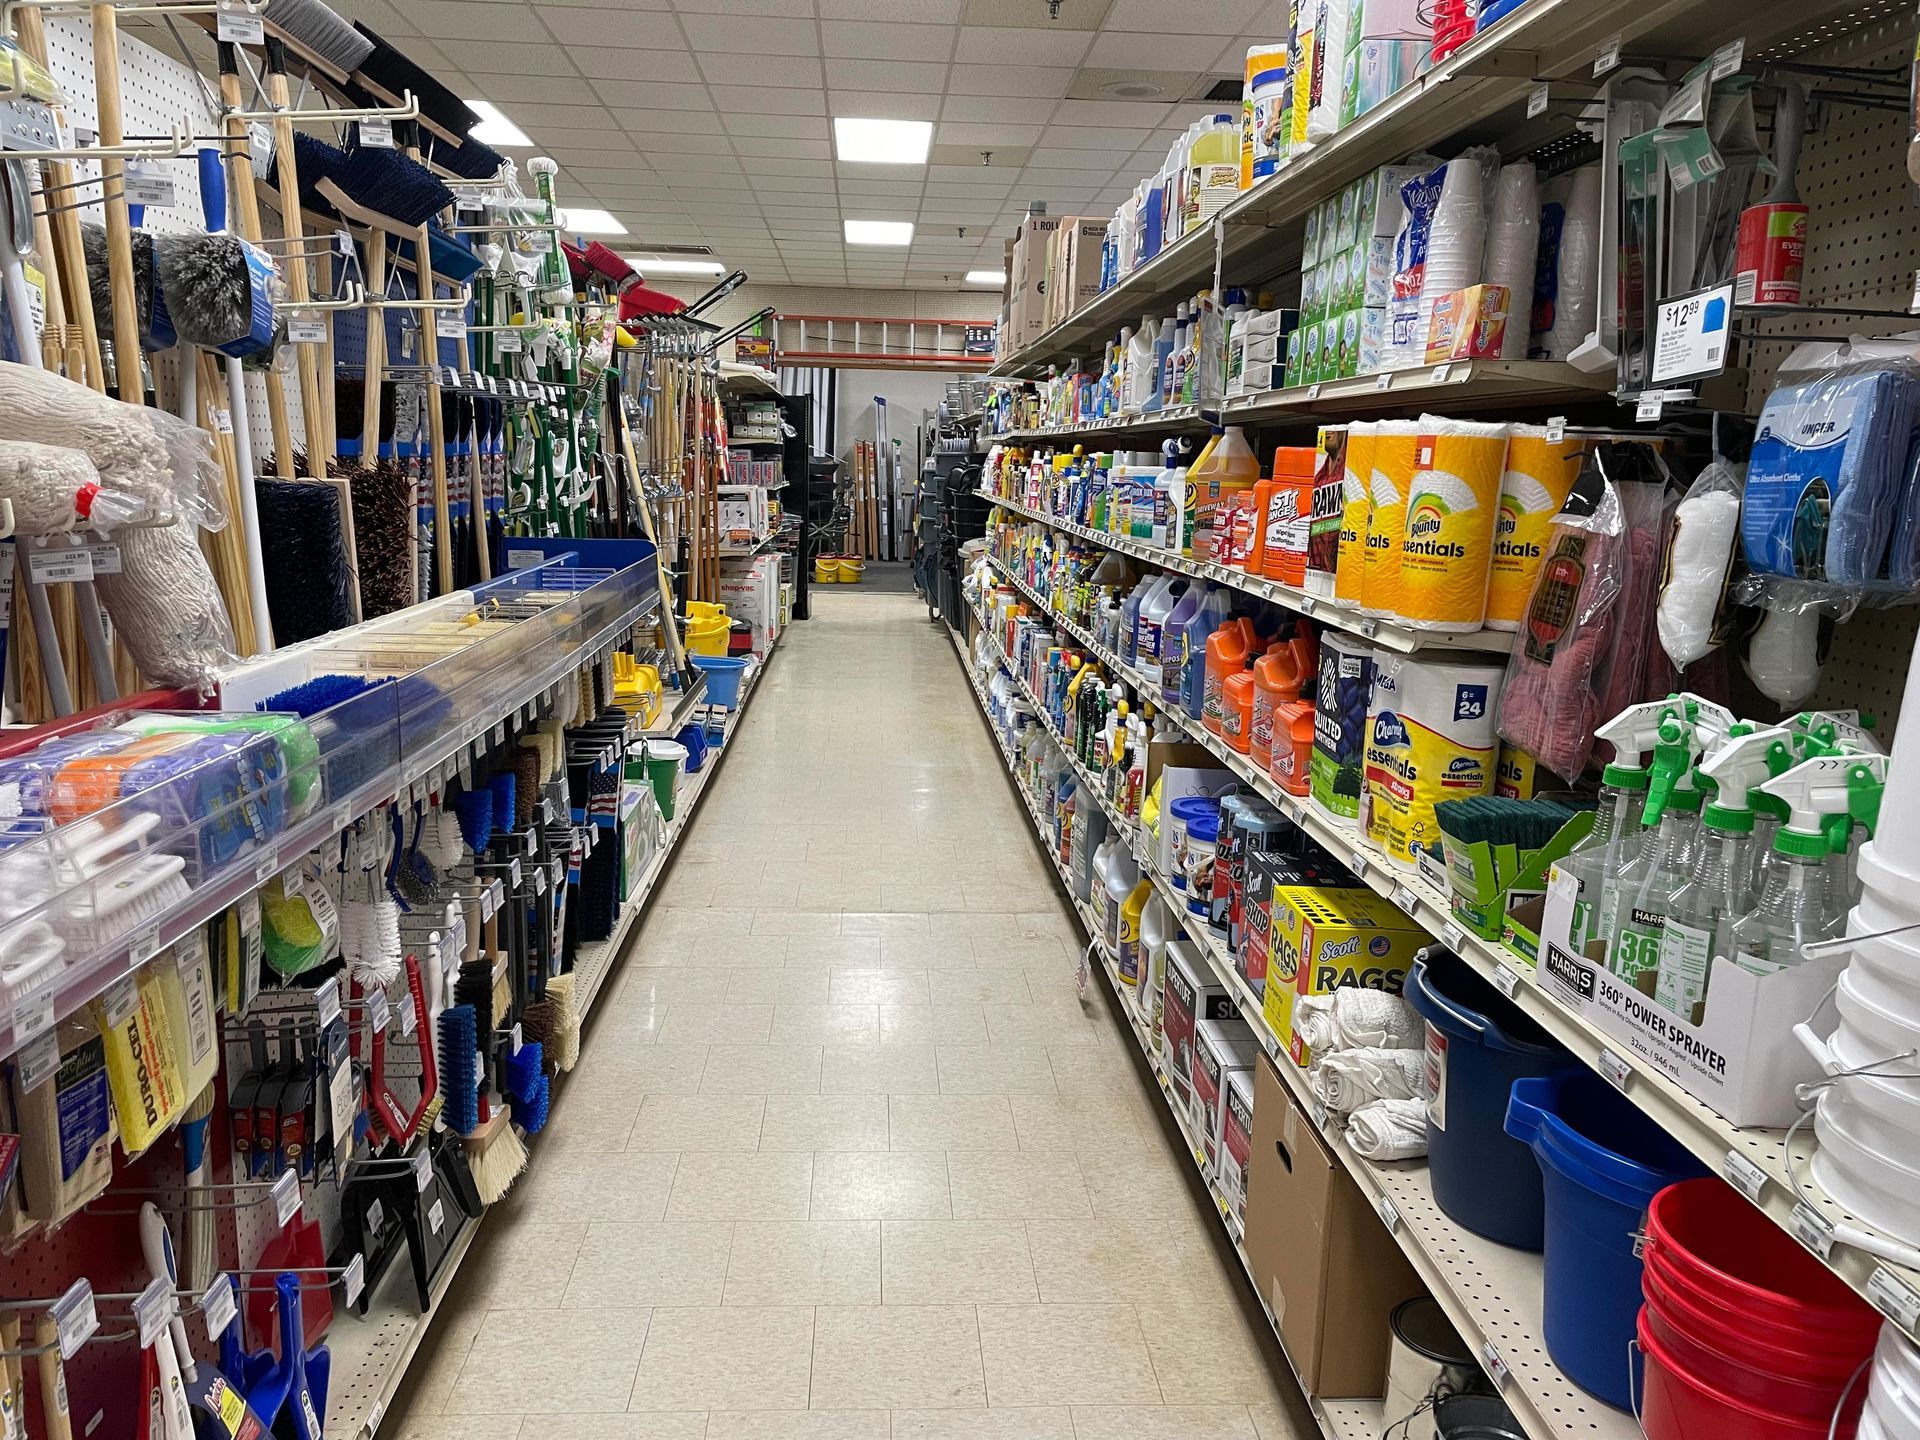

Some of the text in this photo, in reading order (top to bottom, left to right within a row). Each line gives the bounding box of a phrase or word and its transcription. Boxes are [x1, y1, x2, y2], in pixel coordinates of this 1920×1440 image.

[1082, 226, 1089, 236] 6
[1764, 292, 1775, 300] 60
[1411, 518, 1441, 538] Bounty
[1459, 700, 1482, 716] 24
[1315, 710, 1341, 741] QUILTED
[1367, 747, 1417, 780] essentials
[1441, 772, 1484, 780] essentials
[1390, 780, 1410, 800] strong
[1247, 870, 1263, 893] Scott
[1247, 900, 1268, 932] SHOP
[1271, 923, 1298, 976] RAGS
[1319, 936, 1360, 962] Scott
[1316, 966, 1406, 993] RAGS
[1551, 949, 1592, 988] HARRIS
[1167, 961, 1191, 1007] SUPERTUFF
[1599, 980, 1624, 1005] 360°
[1625, 996, 1666, 1037] POWER
[1668, 1025, 1726, 1076] SPRAYER
[1616, 1010, 1625, 1022] Any
[1625, 1017, 1646, 1036] Direction
[1647, 1031, 1666, 1049] Upright
[1668, 1044, 1687, 1062] Angled
[1690, 1060, 1707, 1077] Upside
[1707, 1071, 1724, 1087] Down
[127, 1015, 158, 1129] DURO-CEL
[1654, 1052, 1668, 1068] 946
[1668, 1063, 1681, 1077] mL
